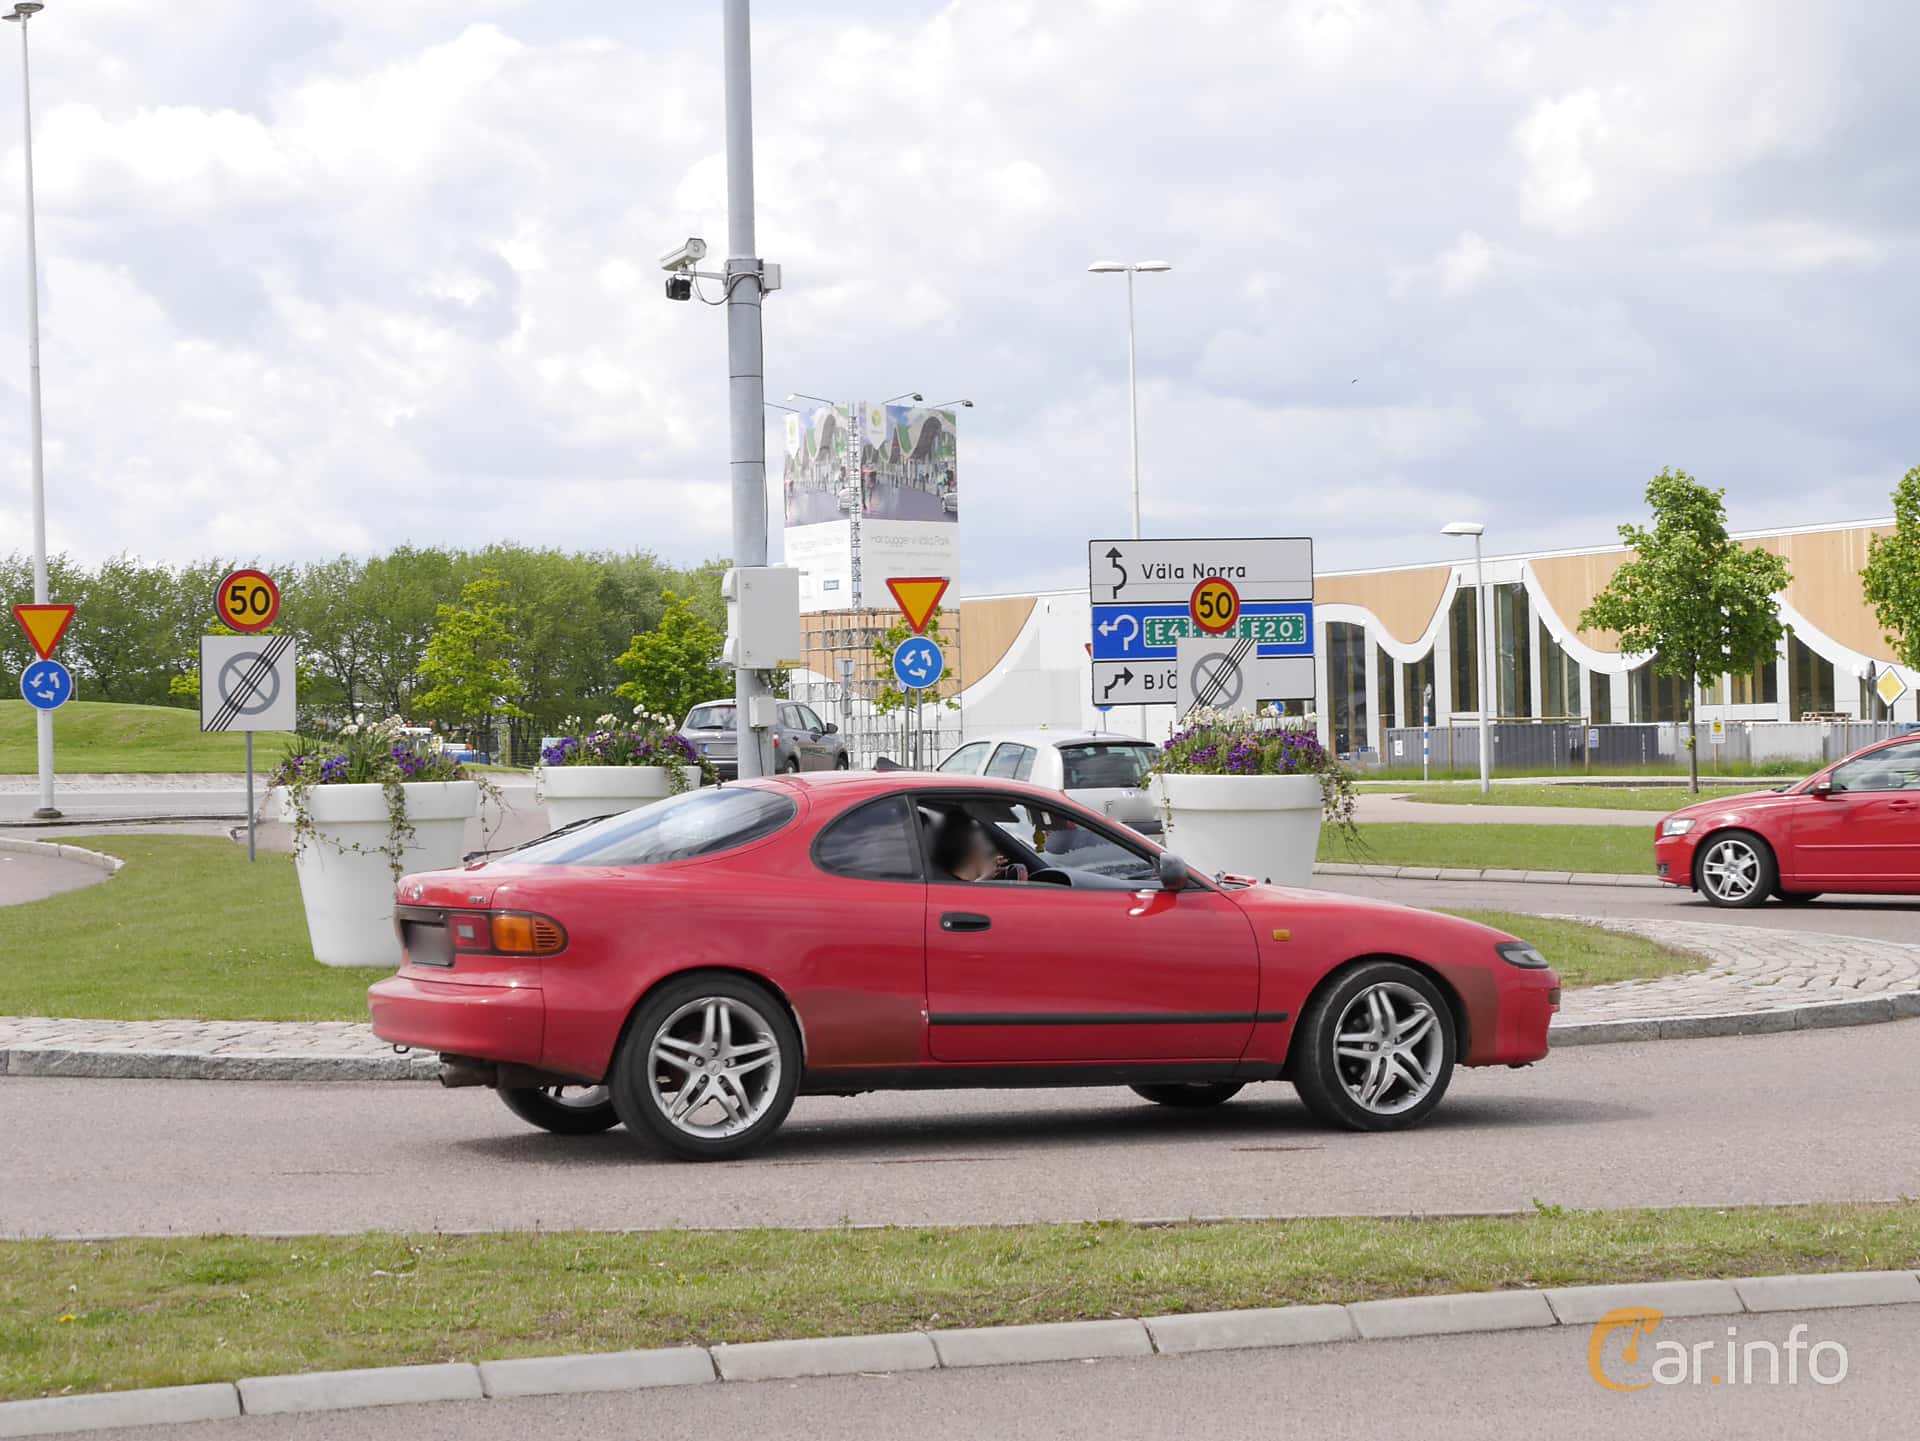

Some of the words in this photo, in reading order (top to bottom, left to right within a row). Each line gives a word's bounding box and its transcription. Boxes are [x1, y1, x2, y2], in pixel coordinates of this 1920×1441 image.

[1141, 563, 1184, 579] Väla
[1192, 563, 1246, 578] Norra
[230, 585, 270, 616] 50
[1199, 591, 1233, 619] 50
[1154, 624, 1181, 639] E4
[1251, 621, 1293, 638] E20
